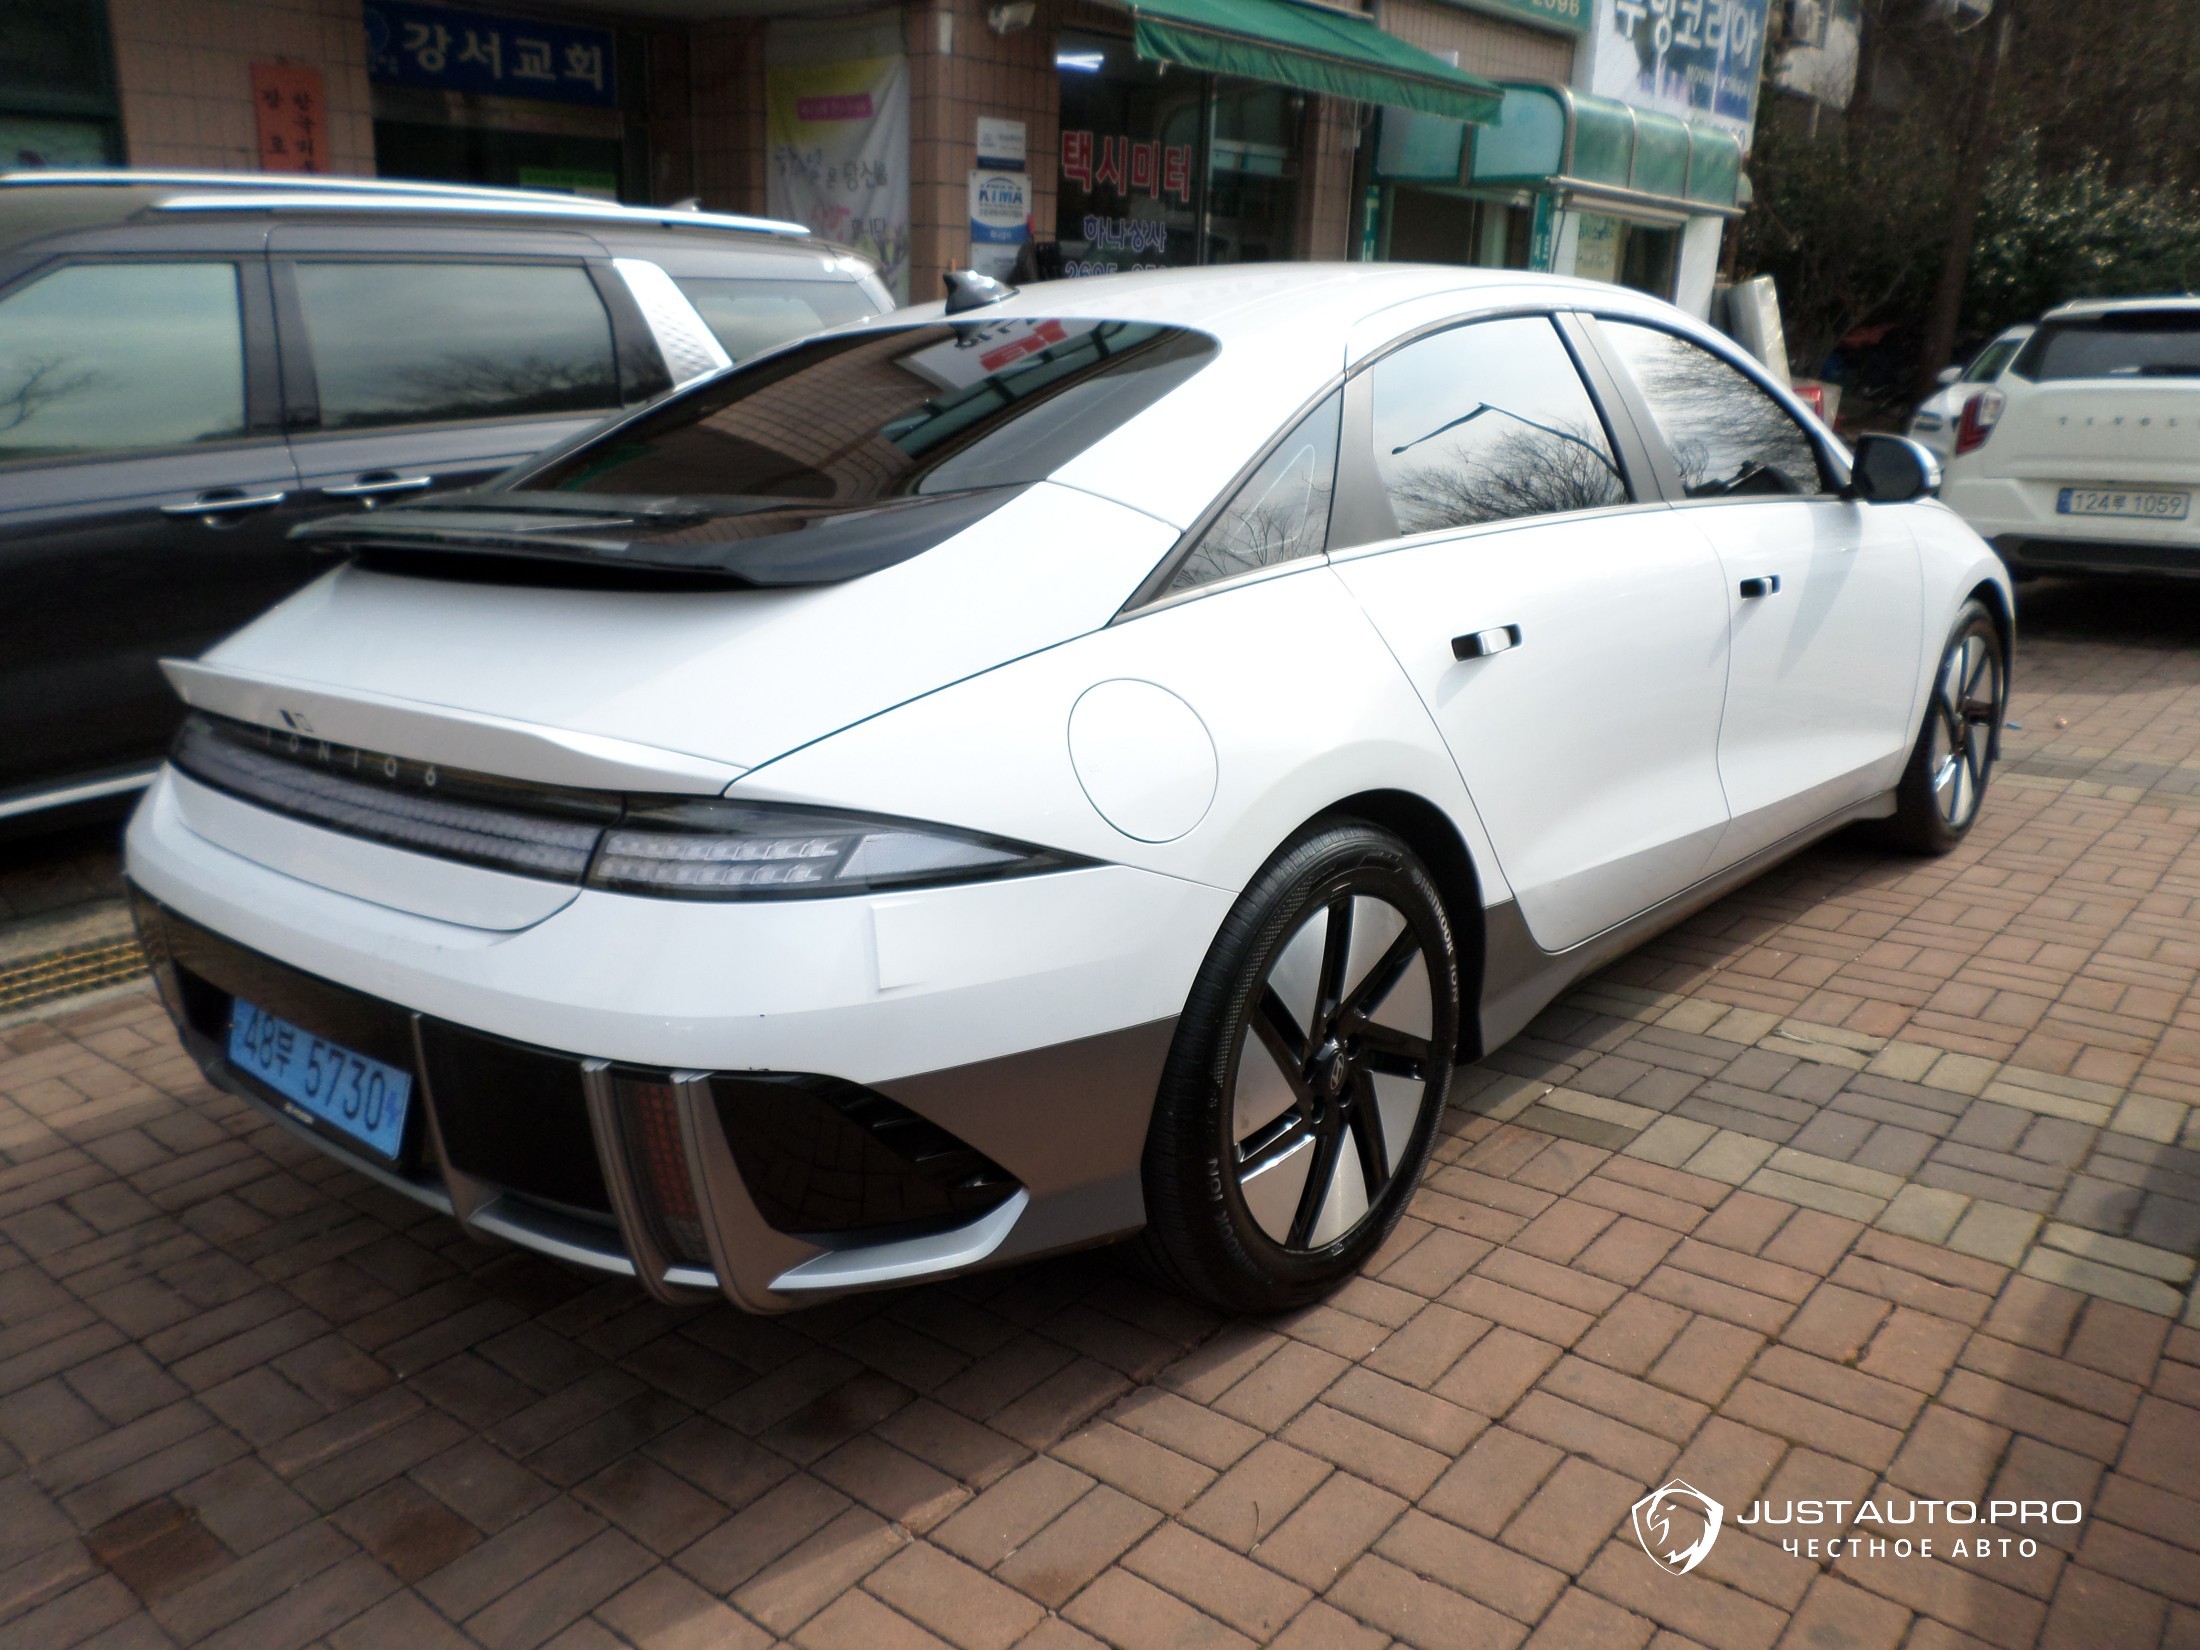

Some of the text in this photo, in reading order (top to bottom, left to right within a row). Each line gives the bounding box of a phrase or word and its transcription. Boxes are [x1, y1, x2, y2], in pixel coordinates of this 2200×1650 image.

[403, 21, 604, 91] 강서교회
[1062, 130, 1192, 204] 택시미터
[1084, 215, 1167, 253] 하나상사
[2134, 494, 2182, 514] 1059
[305, 1038, 386, 1133] 5730
